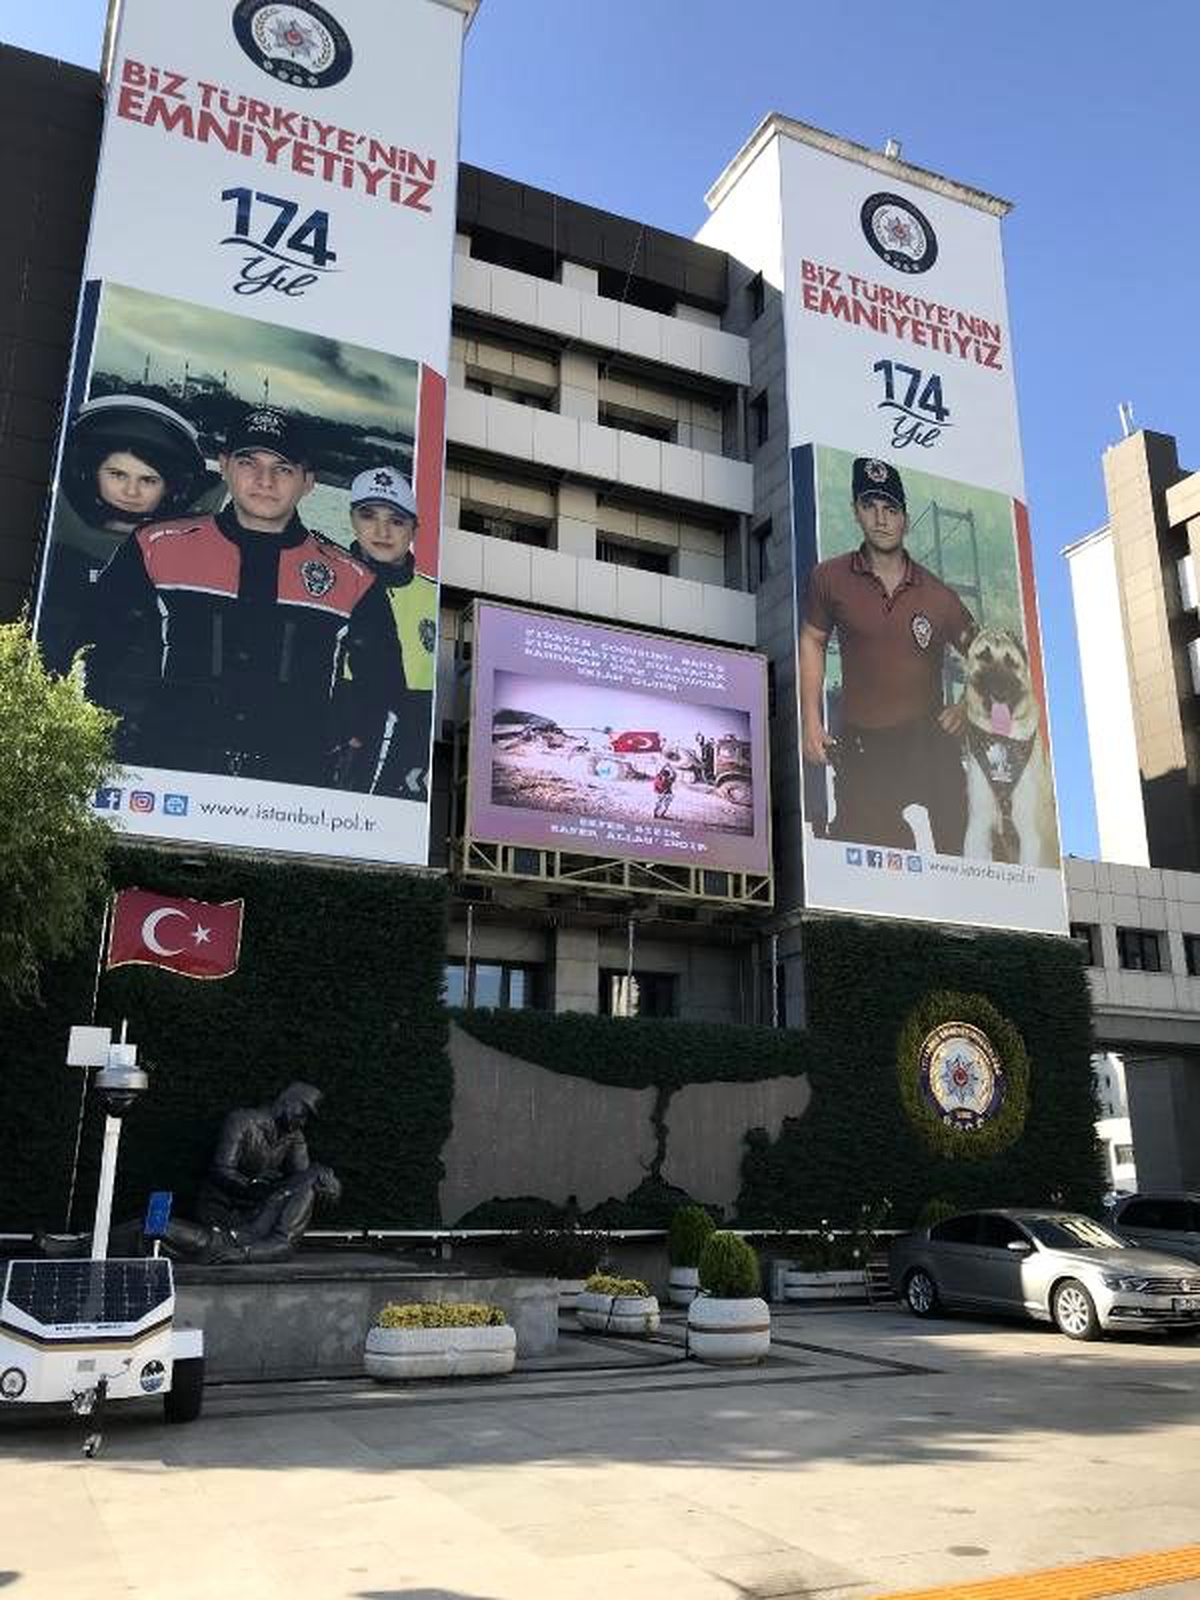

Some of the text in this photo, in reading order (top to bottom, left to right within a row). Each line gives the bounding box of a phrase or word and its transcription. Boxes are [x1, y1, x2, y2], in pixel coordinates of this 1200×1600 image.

[221, 187, 337, 266] 174
[873, 359, 950, 422] 174
[200, 801, 377, 832] www.istanbul.pol.tr
